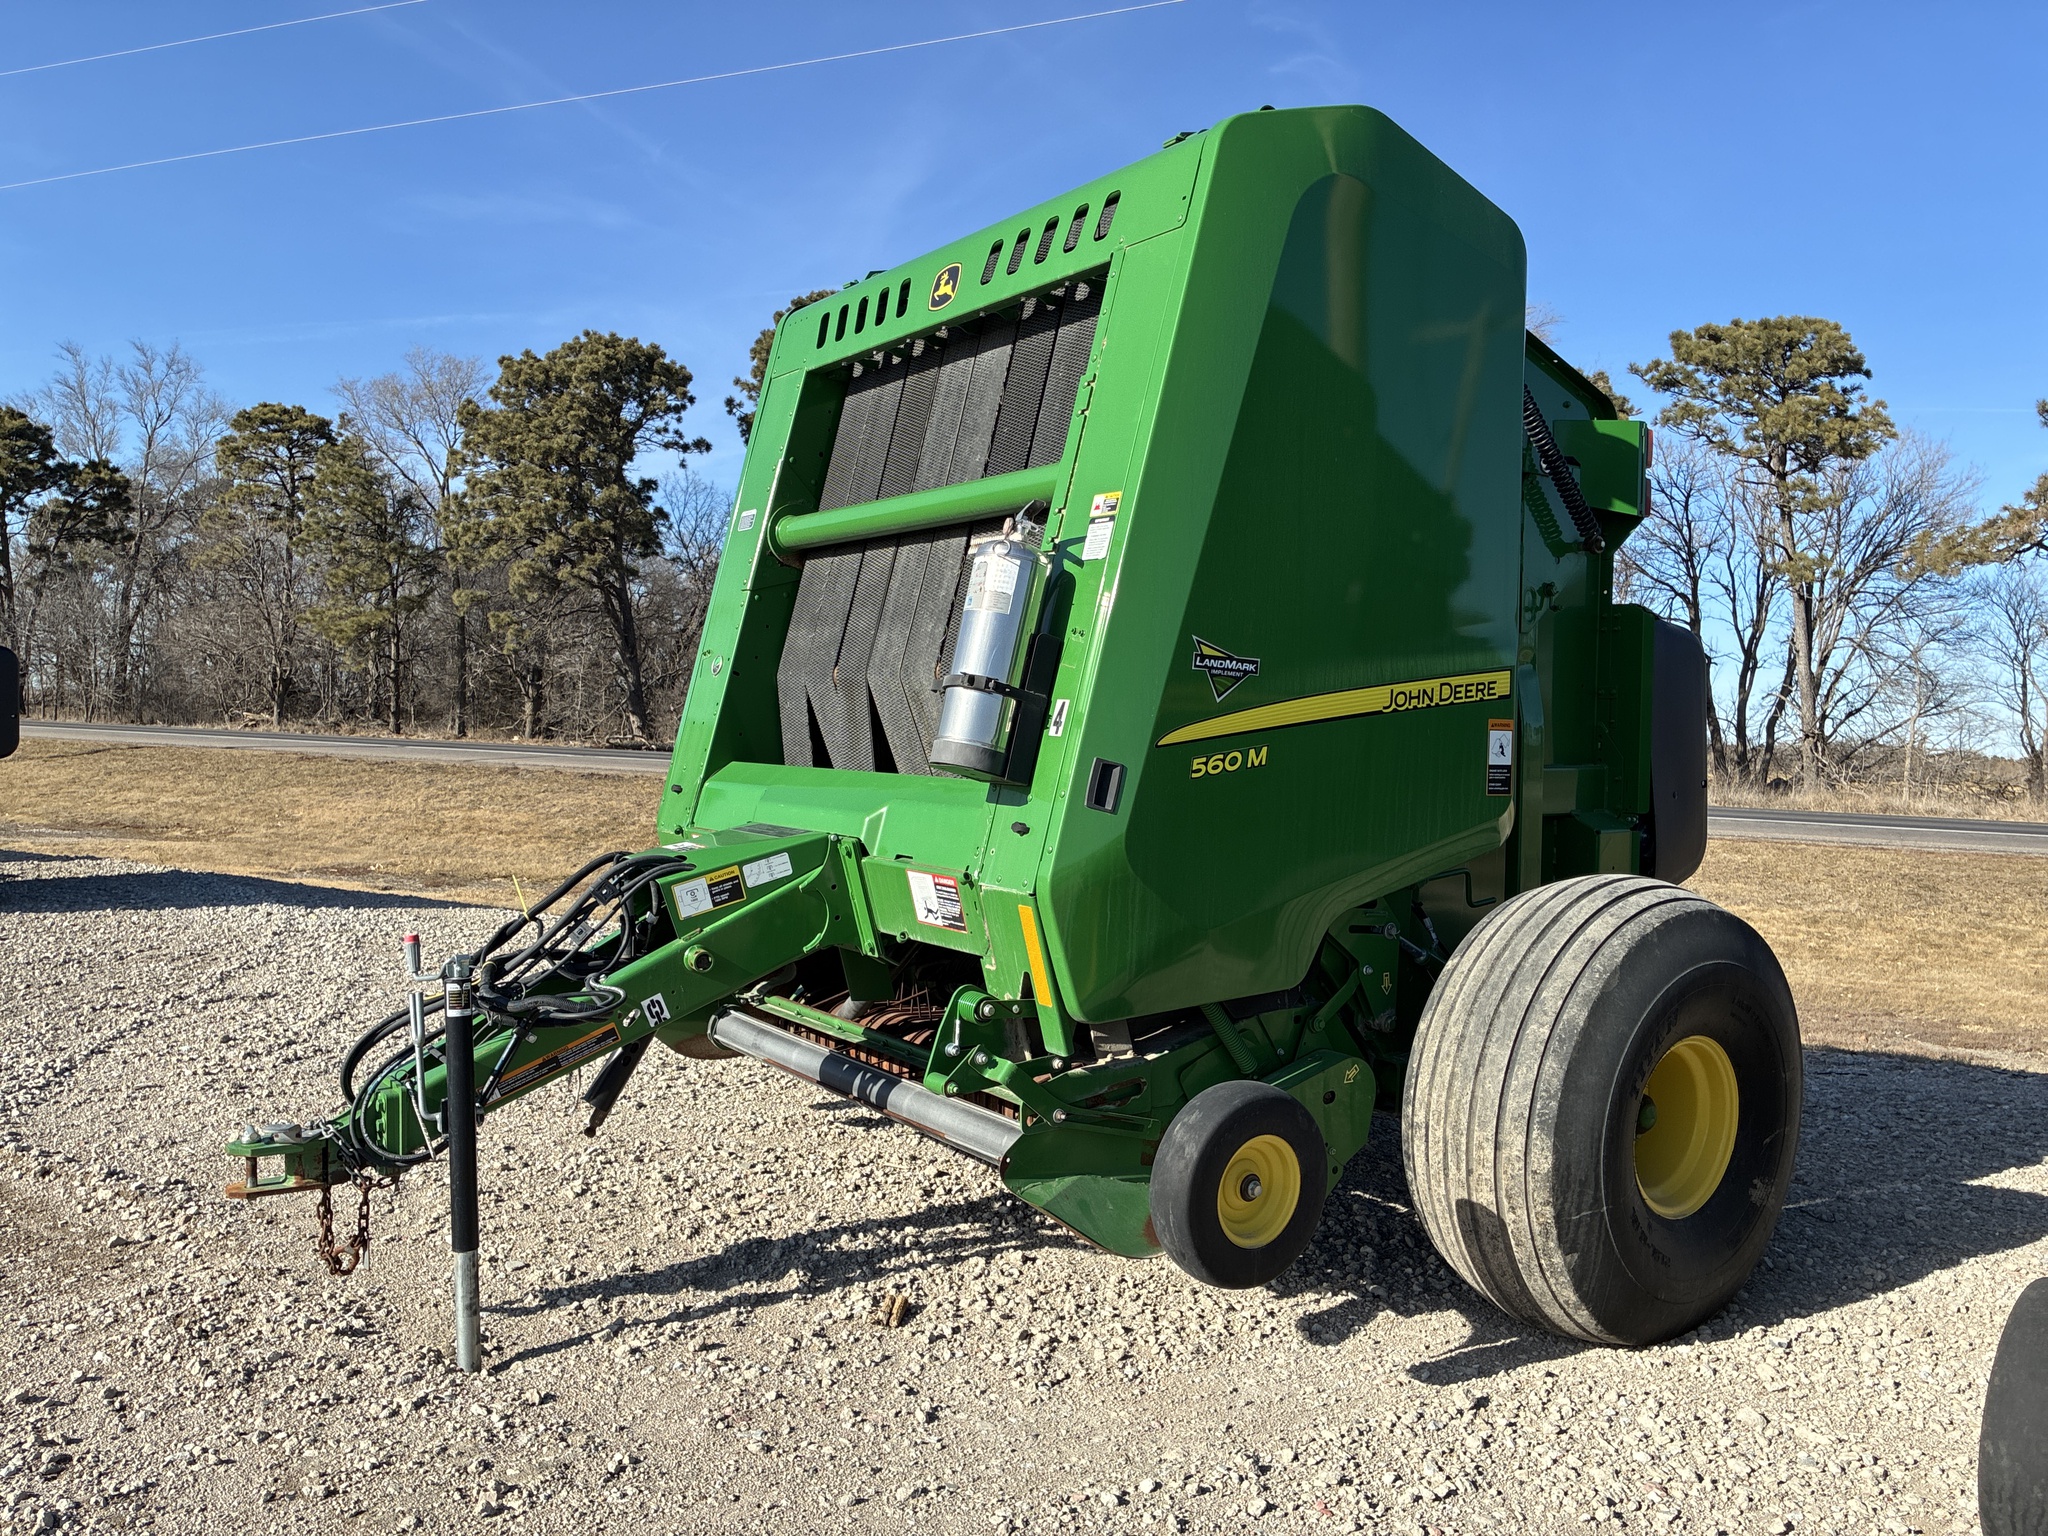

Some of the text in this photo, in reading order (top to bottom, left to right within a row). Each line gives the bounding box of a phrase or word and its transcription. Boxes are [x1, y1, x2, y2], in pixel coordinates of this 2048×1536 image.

[1196, 656, 1257, 672] LANDMARK
[1210, 669, 1244, 678] IMPLEMENT
[1382, 680, 1498, 710] JOHN DEERE
[1191, 746, 1268, 779] 560 M
[713, 869, 736, 881] CAUTION
